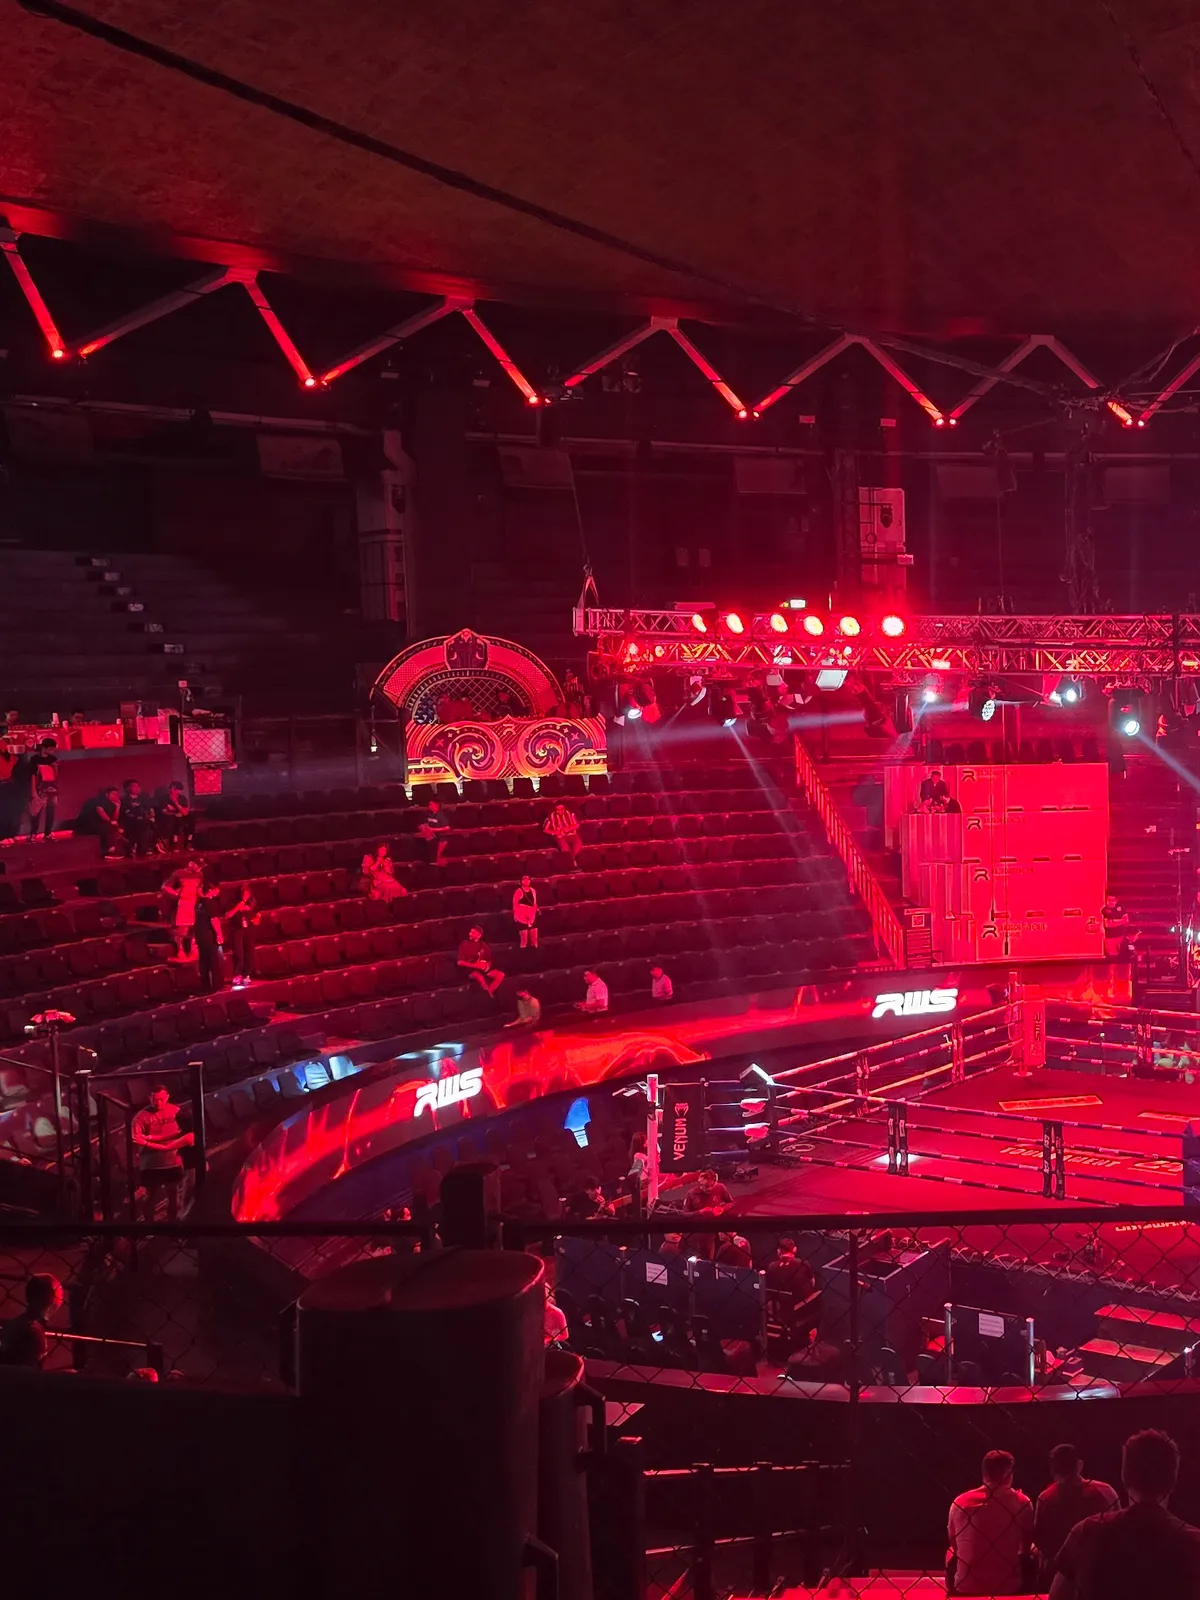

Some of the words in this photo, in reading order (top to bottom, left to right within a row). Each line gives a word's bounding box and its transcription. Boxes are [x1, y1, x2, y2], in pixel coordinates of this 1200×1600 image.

[872, 988, 959, 1018] RWS
[413, 1067, 484, 1117] RWS
[673, 1118, 688, 1161] VENUM
[1000, 1146, 1121, 1168] TOURAMENT
